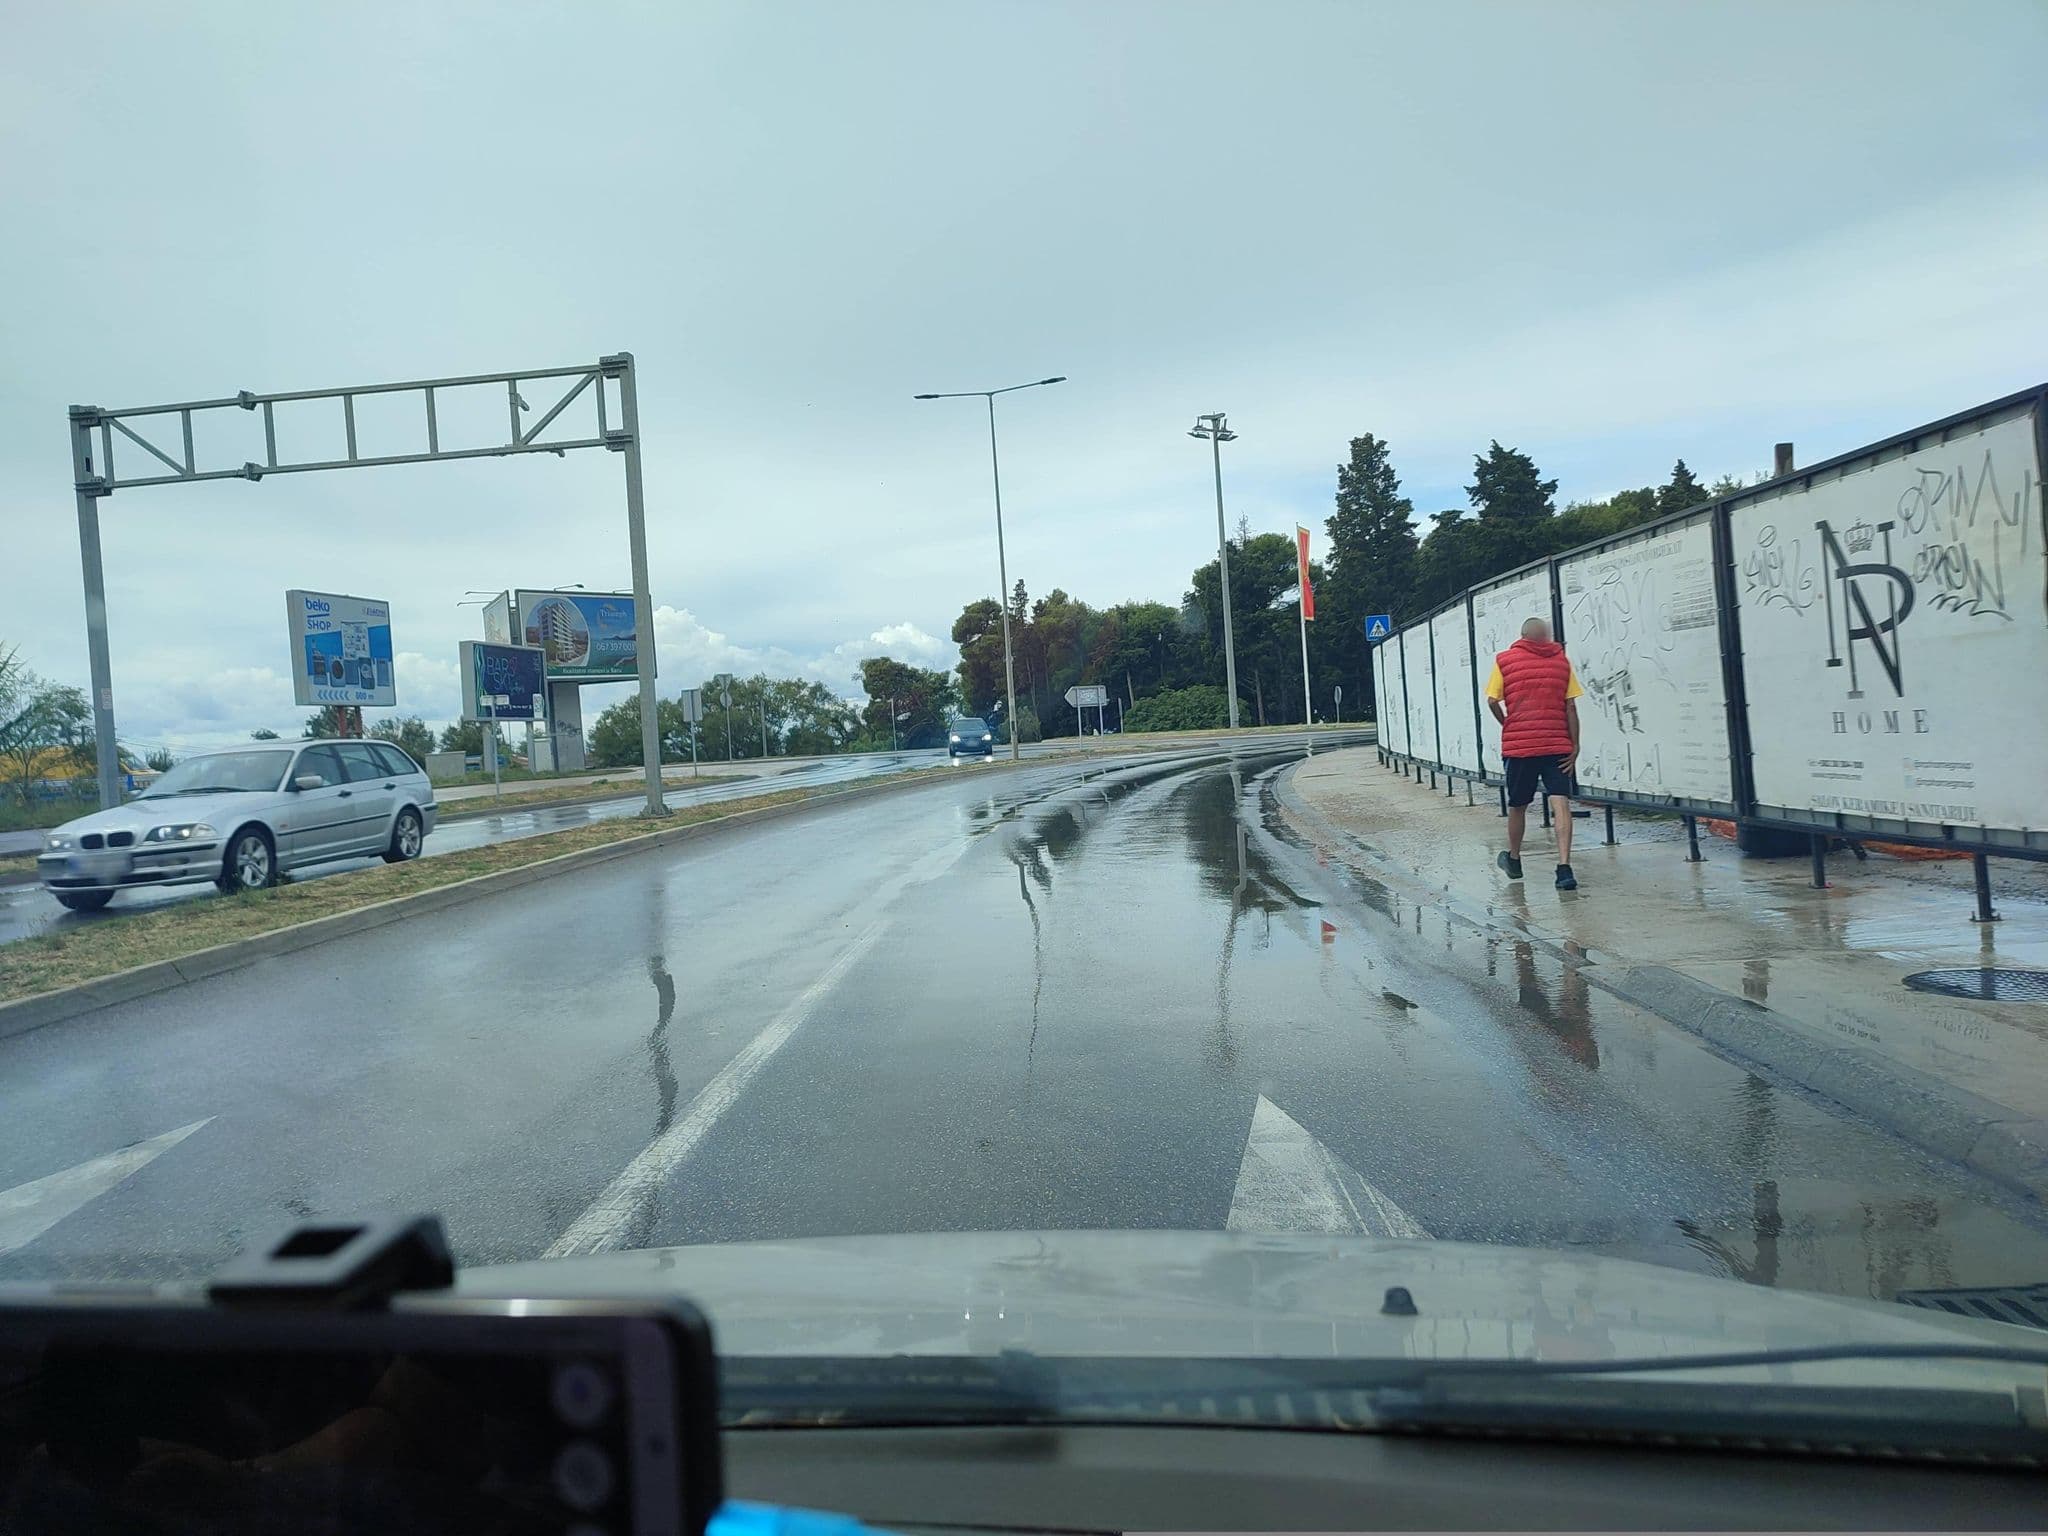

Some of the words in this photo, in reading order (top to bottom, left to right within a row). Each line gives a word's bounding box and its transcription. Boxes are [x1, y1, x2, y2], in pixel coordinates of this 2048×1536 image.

[305, 597, 330, 612] beko
[307, 619, 332, 631] SHOP
[1832, 709, 1930, 735] HOME
